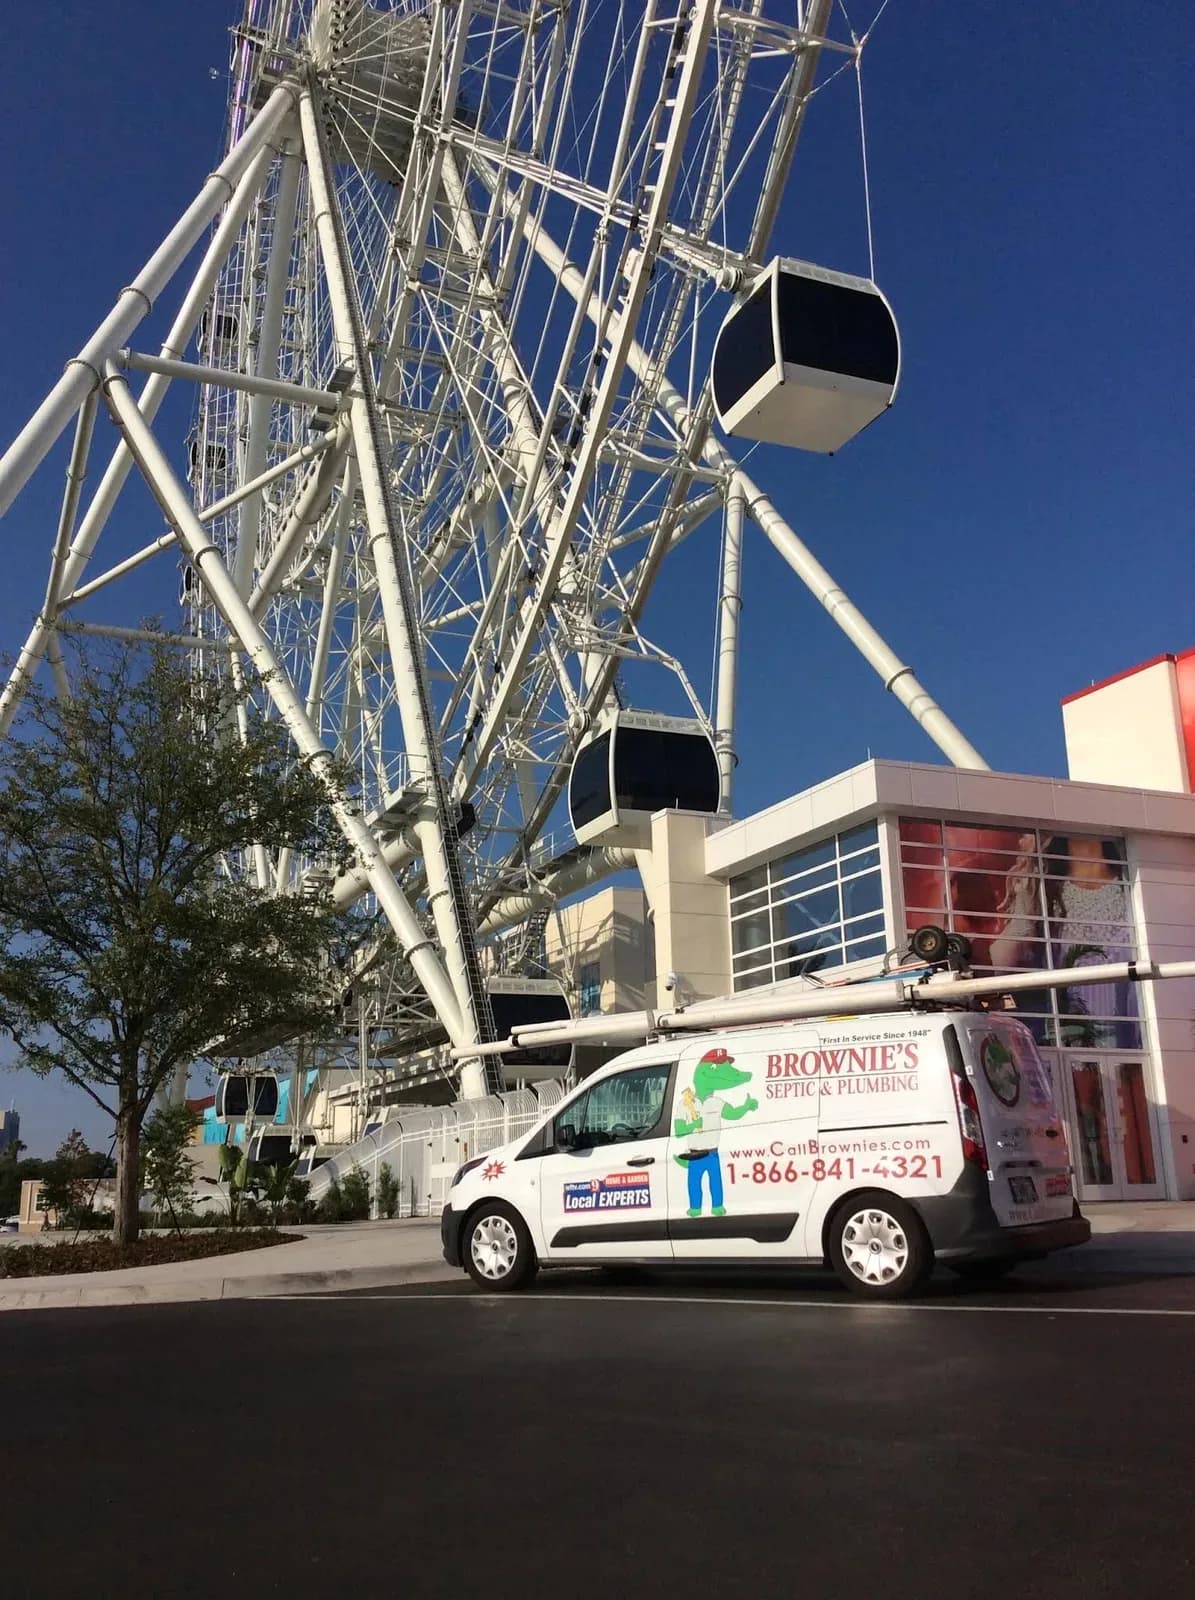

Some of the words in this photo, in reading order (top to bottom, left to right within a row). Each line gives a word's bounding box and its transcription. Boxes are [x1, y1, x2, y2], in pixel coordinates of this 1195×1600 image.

[852, 1034, 881, 1042] Service
[883, 1031, 905, 1039] Since
[766, 1043, 919, 1079] BROWNIE'S
[766, 1080, 816, 1099] SEPTIC
[820, 1081, 832, 1096] &
[837, 1074, 919, 1095] PLUMBING
[729, 1138, 931, 1159] www.CallBrownies.com
[727, 1155, 943, 1185] 1-866-841-4321
[566, 1192, 597, 1209] Local
[598, 1189, 649, 1208] EXPERTS
